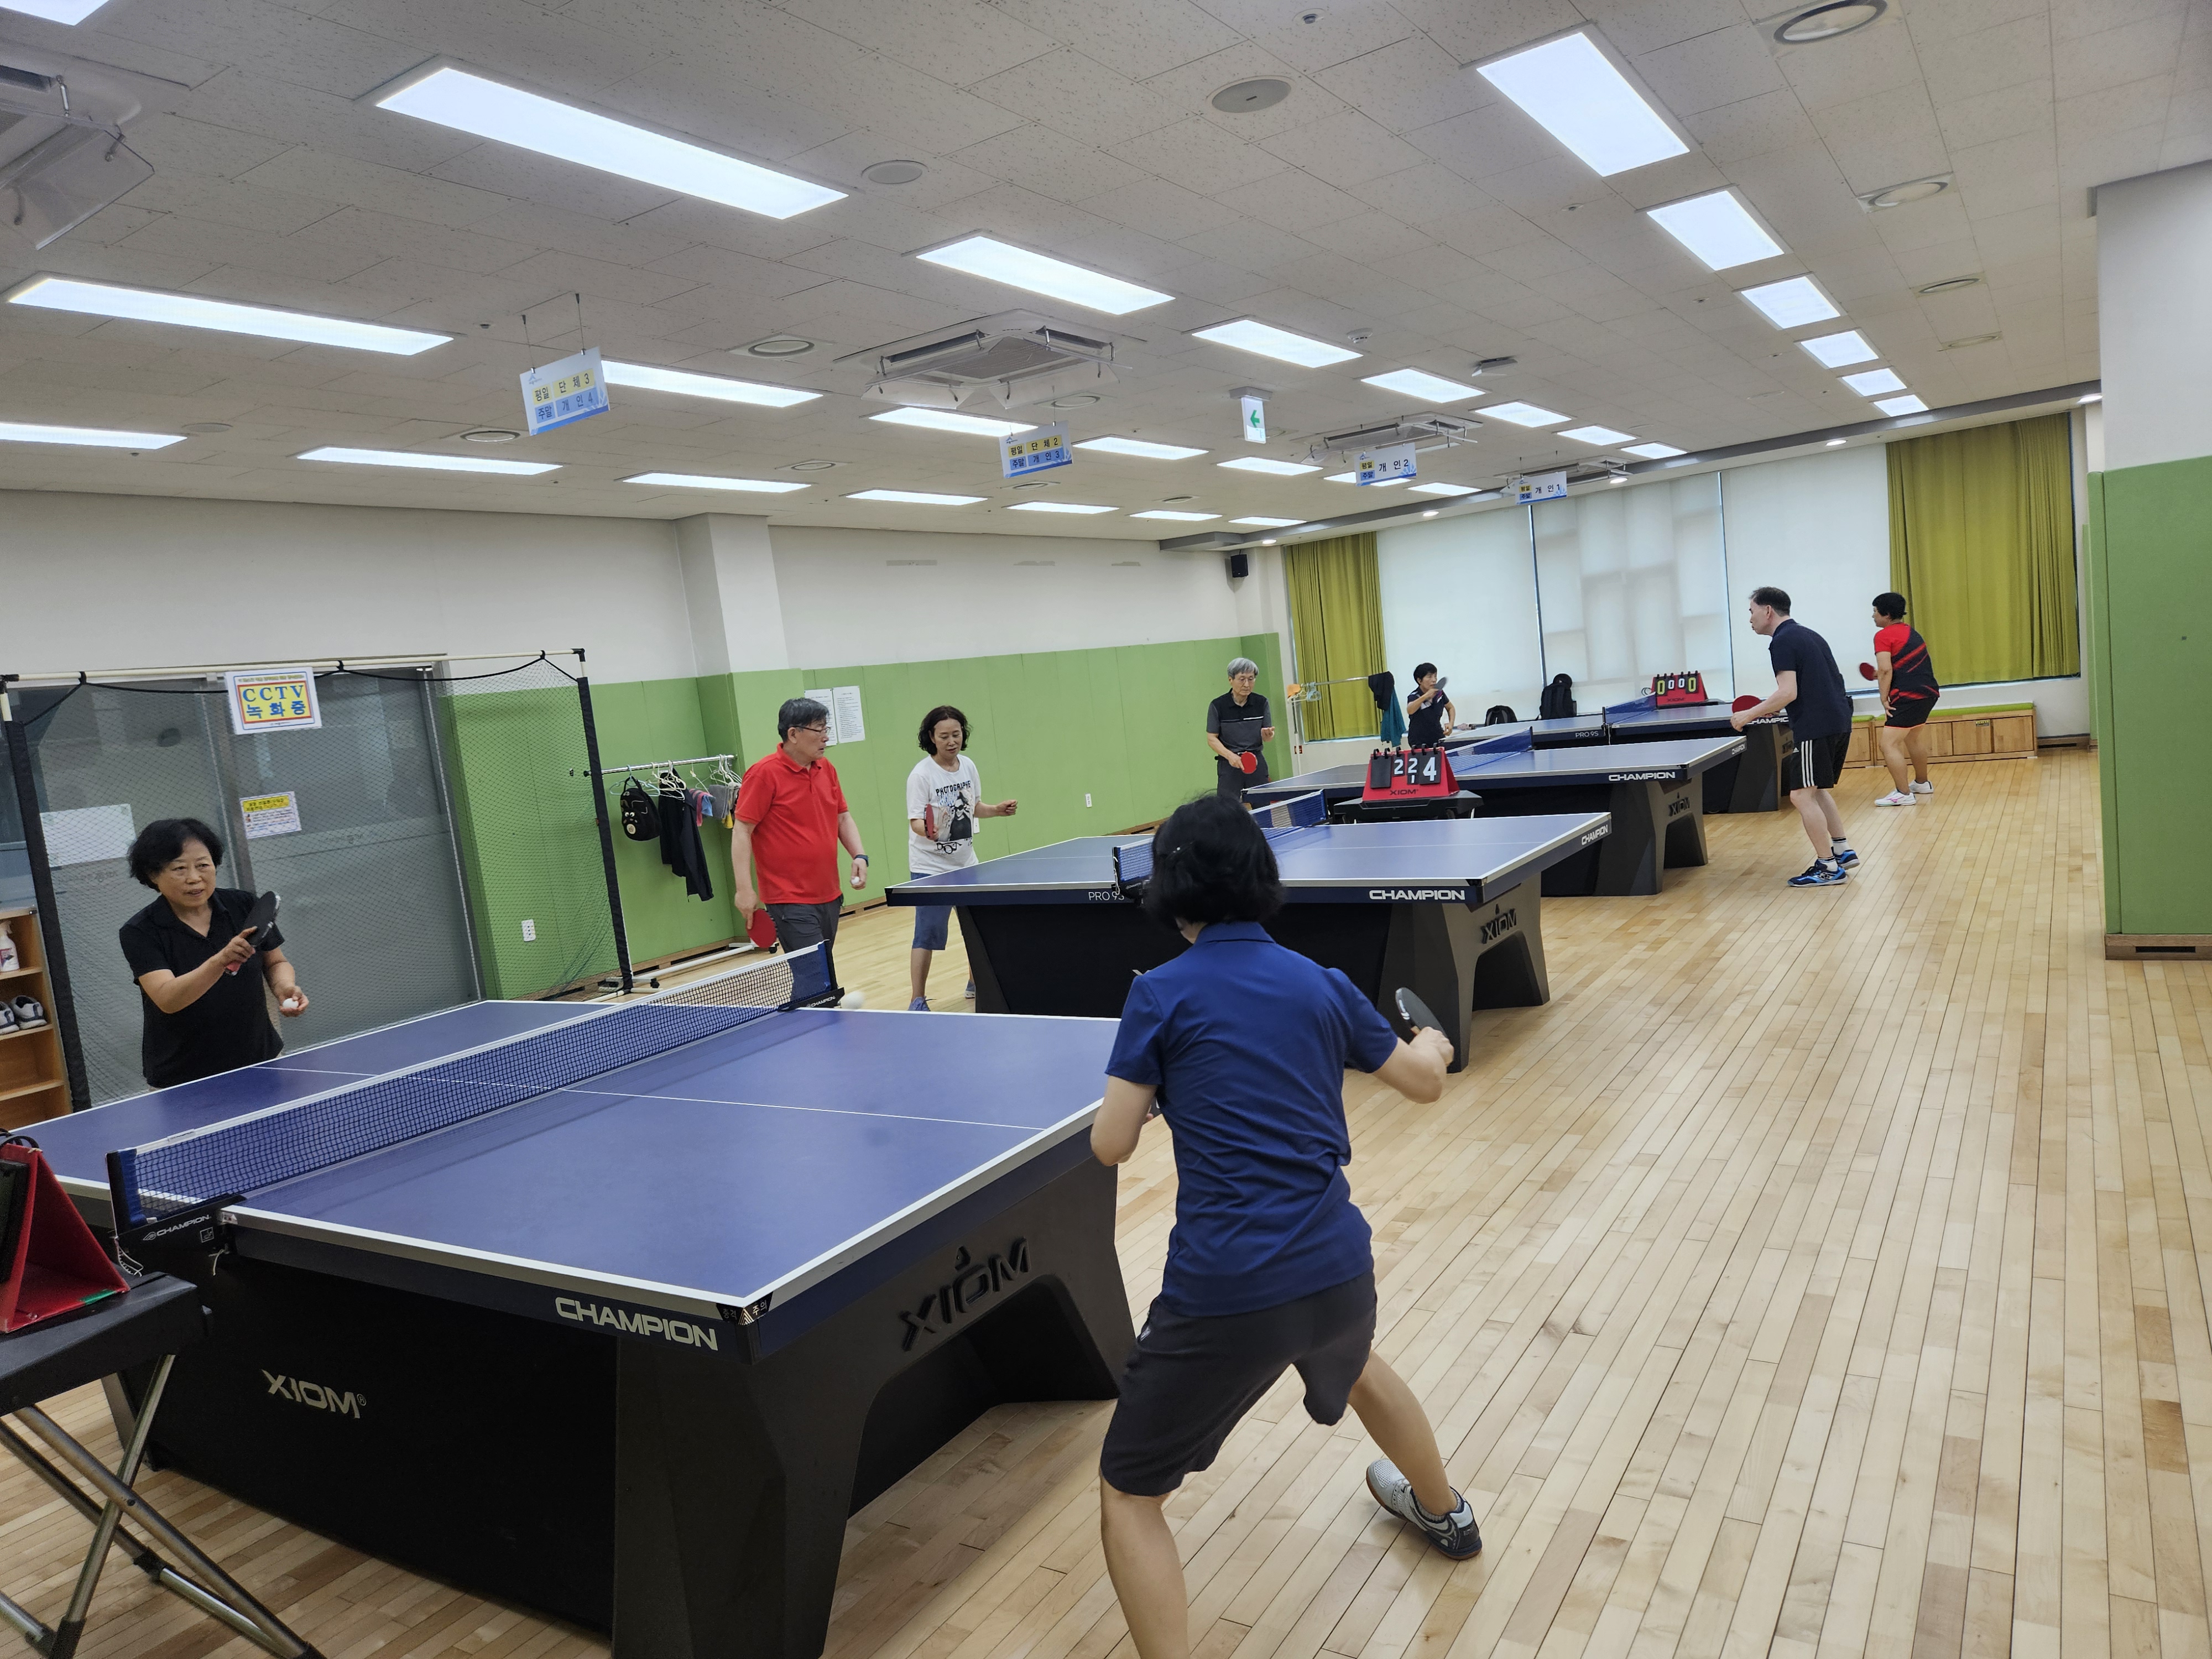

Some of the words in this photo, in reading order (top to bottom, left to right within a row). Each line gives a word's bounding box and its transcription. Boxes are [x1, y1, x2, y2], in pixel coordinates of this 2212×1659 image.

[534, 386, 550, 401] 평일
[538, 405, 552, 420] 주말
[1010, 445, 1023, 456] 평일
[1012, 458, 1025, 468] 주말
[242, 685, 304, 702] CCTV
[246, 700, 306, 719] 녹화중
[1608, 771, 1676, 782] CHAMPION
[1582, 824, 1608, 846] CHAMPION
[1088, 891, 1110, 901] PRO
[1369, 890, 1465, 901] CHAMPION
[1481, 908, 1517, 945] XIOM
[156, 1214, 210, 1237] CHAMPION
[899, 1237, 1032, 1352] XIOM
[753, 1300, 767, 1316] 주의
[555, 1296, 718, 1351] CHAMPION
